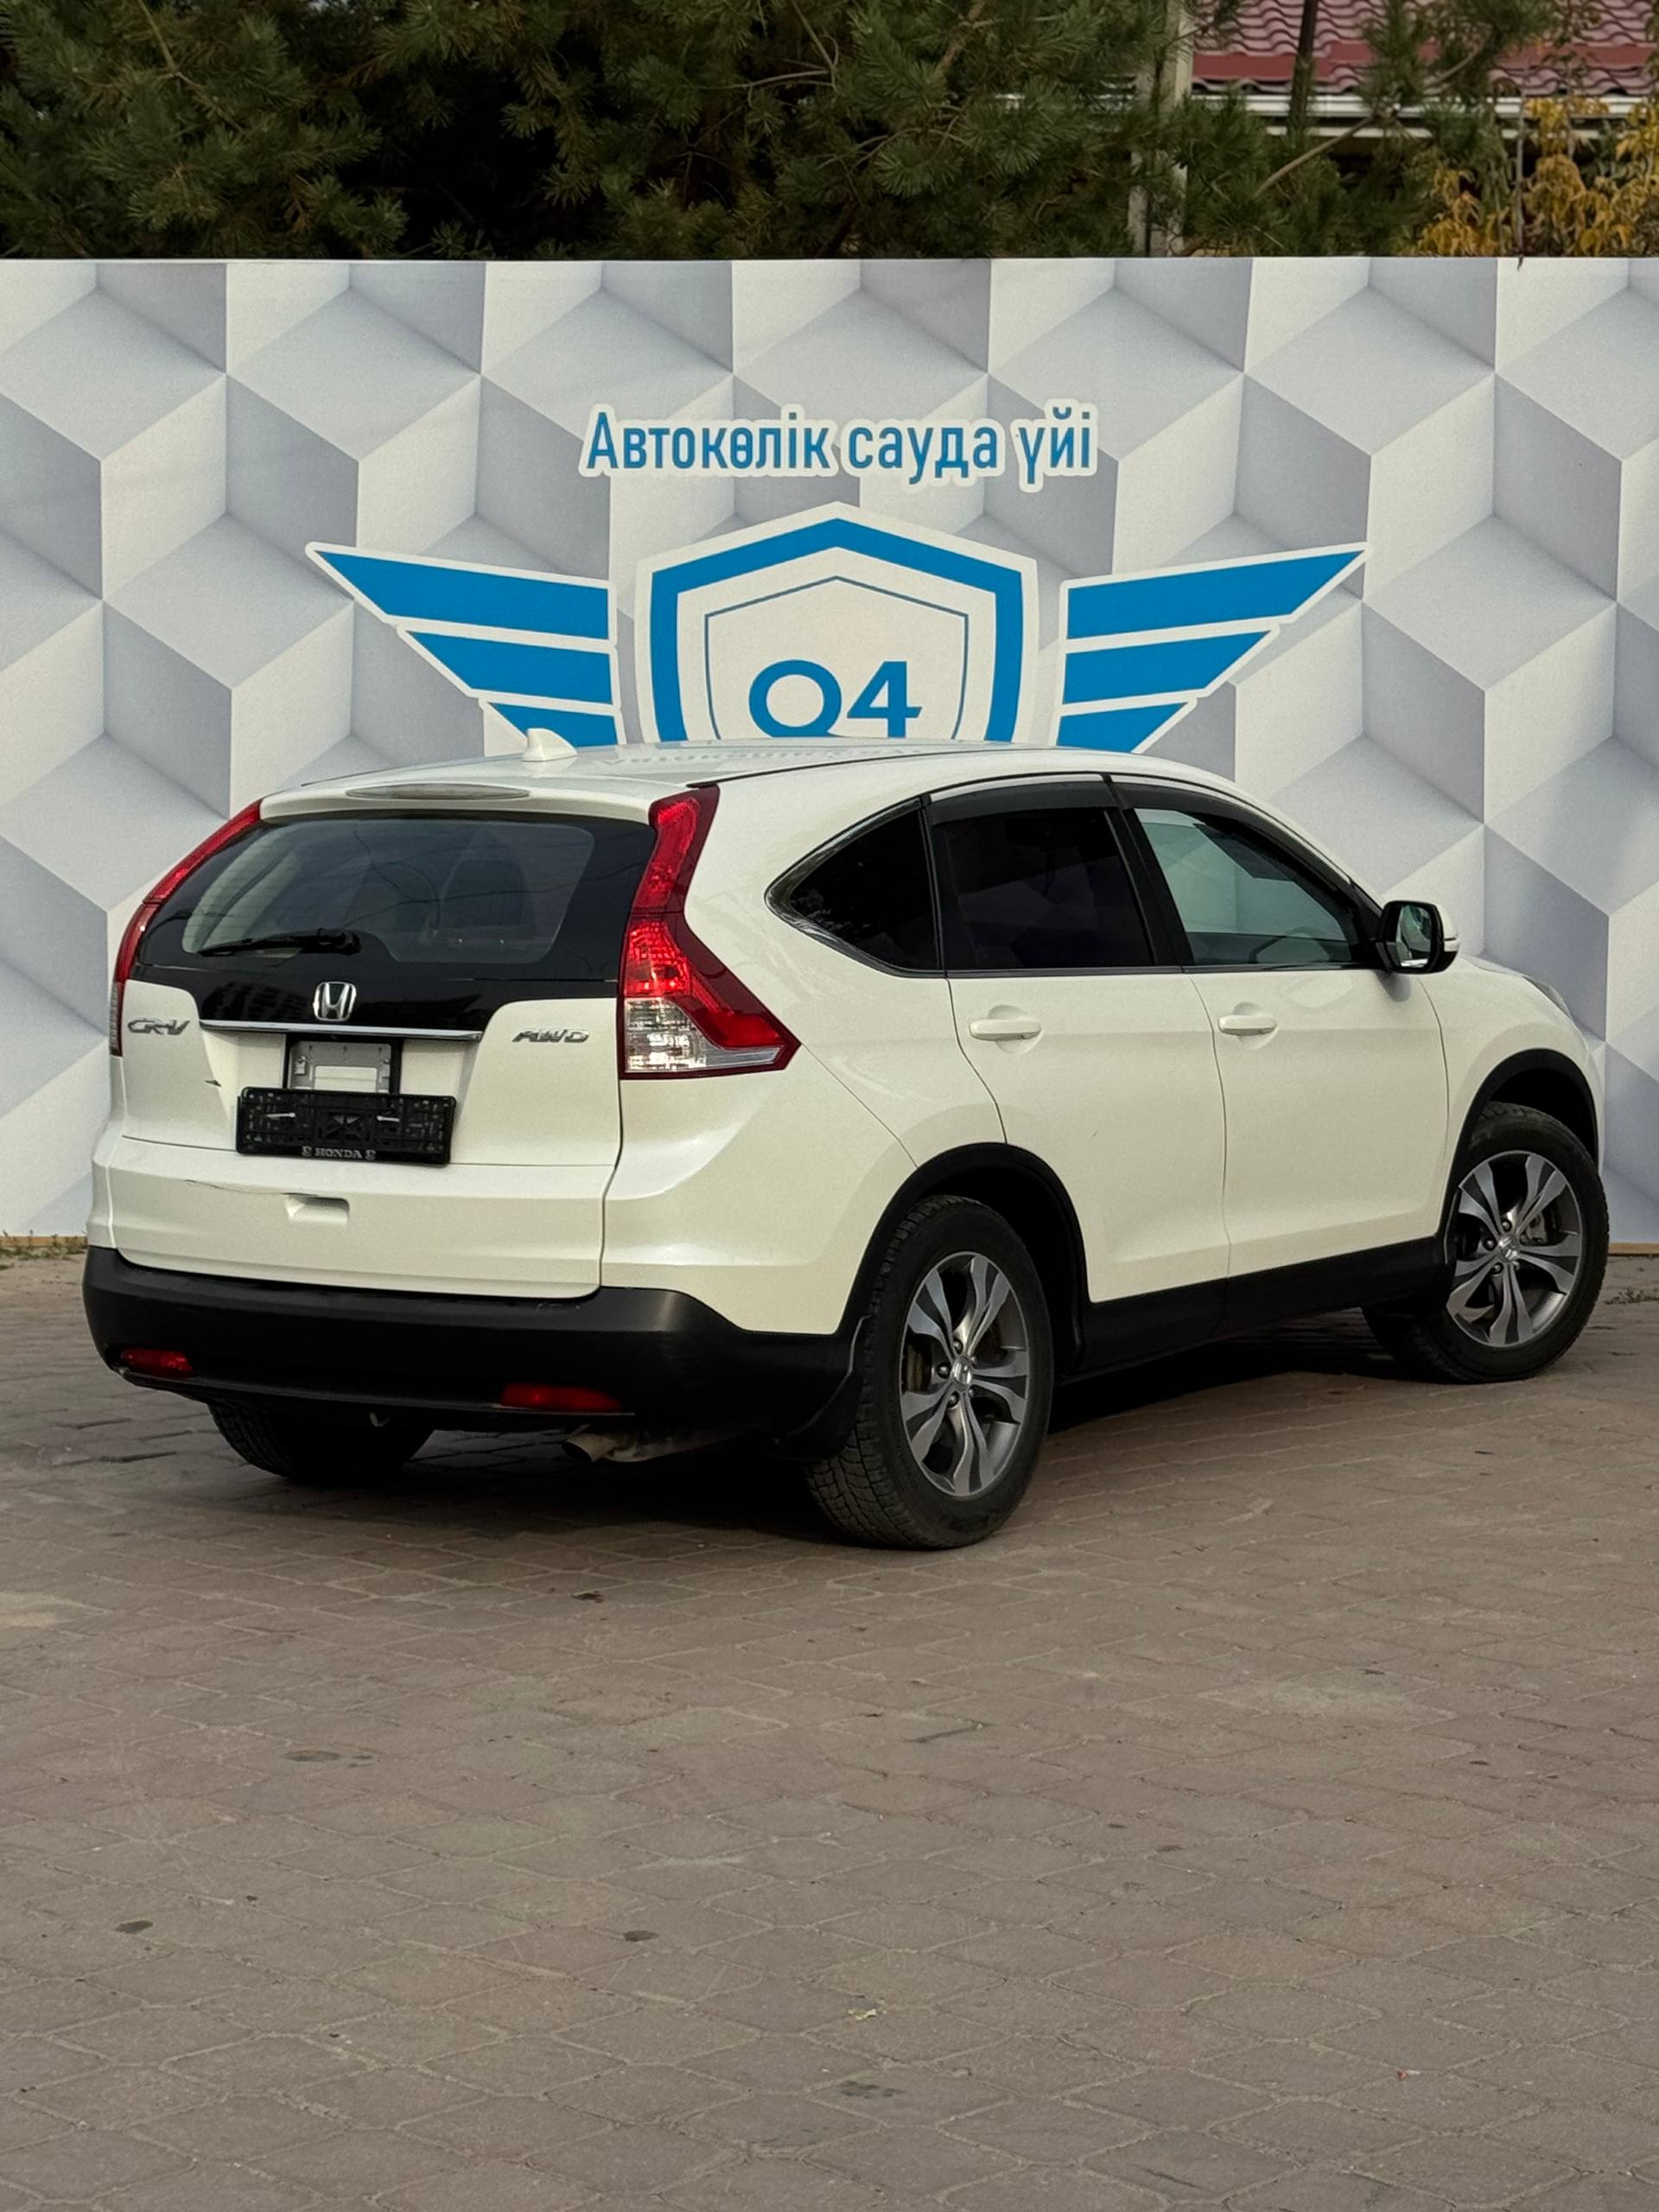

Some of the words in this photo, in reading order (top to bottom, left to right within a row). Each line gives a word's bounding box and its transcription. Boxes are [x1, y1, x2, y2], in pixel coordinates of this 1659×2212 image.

[587, 411, 831, 469] Автокөлік
[848, 426, 998, 486] сауда
[1017, 407, 1091, 485] үйі
[512, 1028, 590, 1044] AWD
[314, 1147, 363, 1160] HONDA
